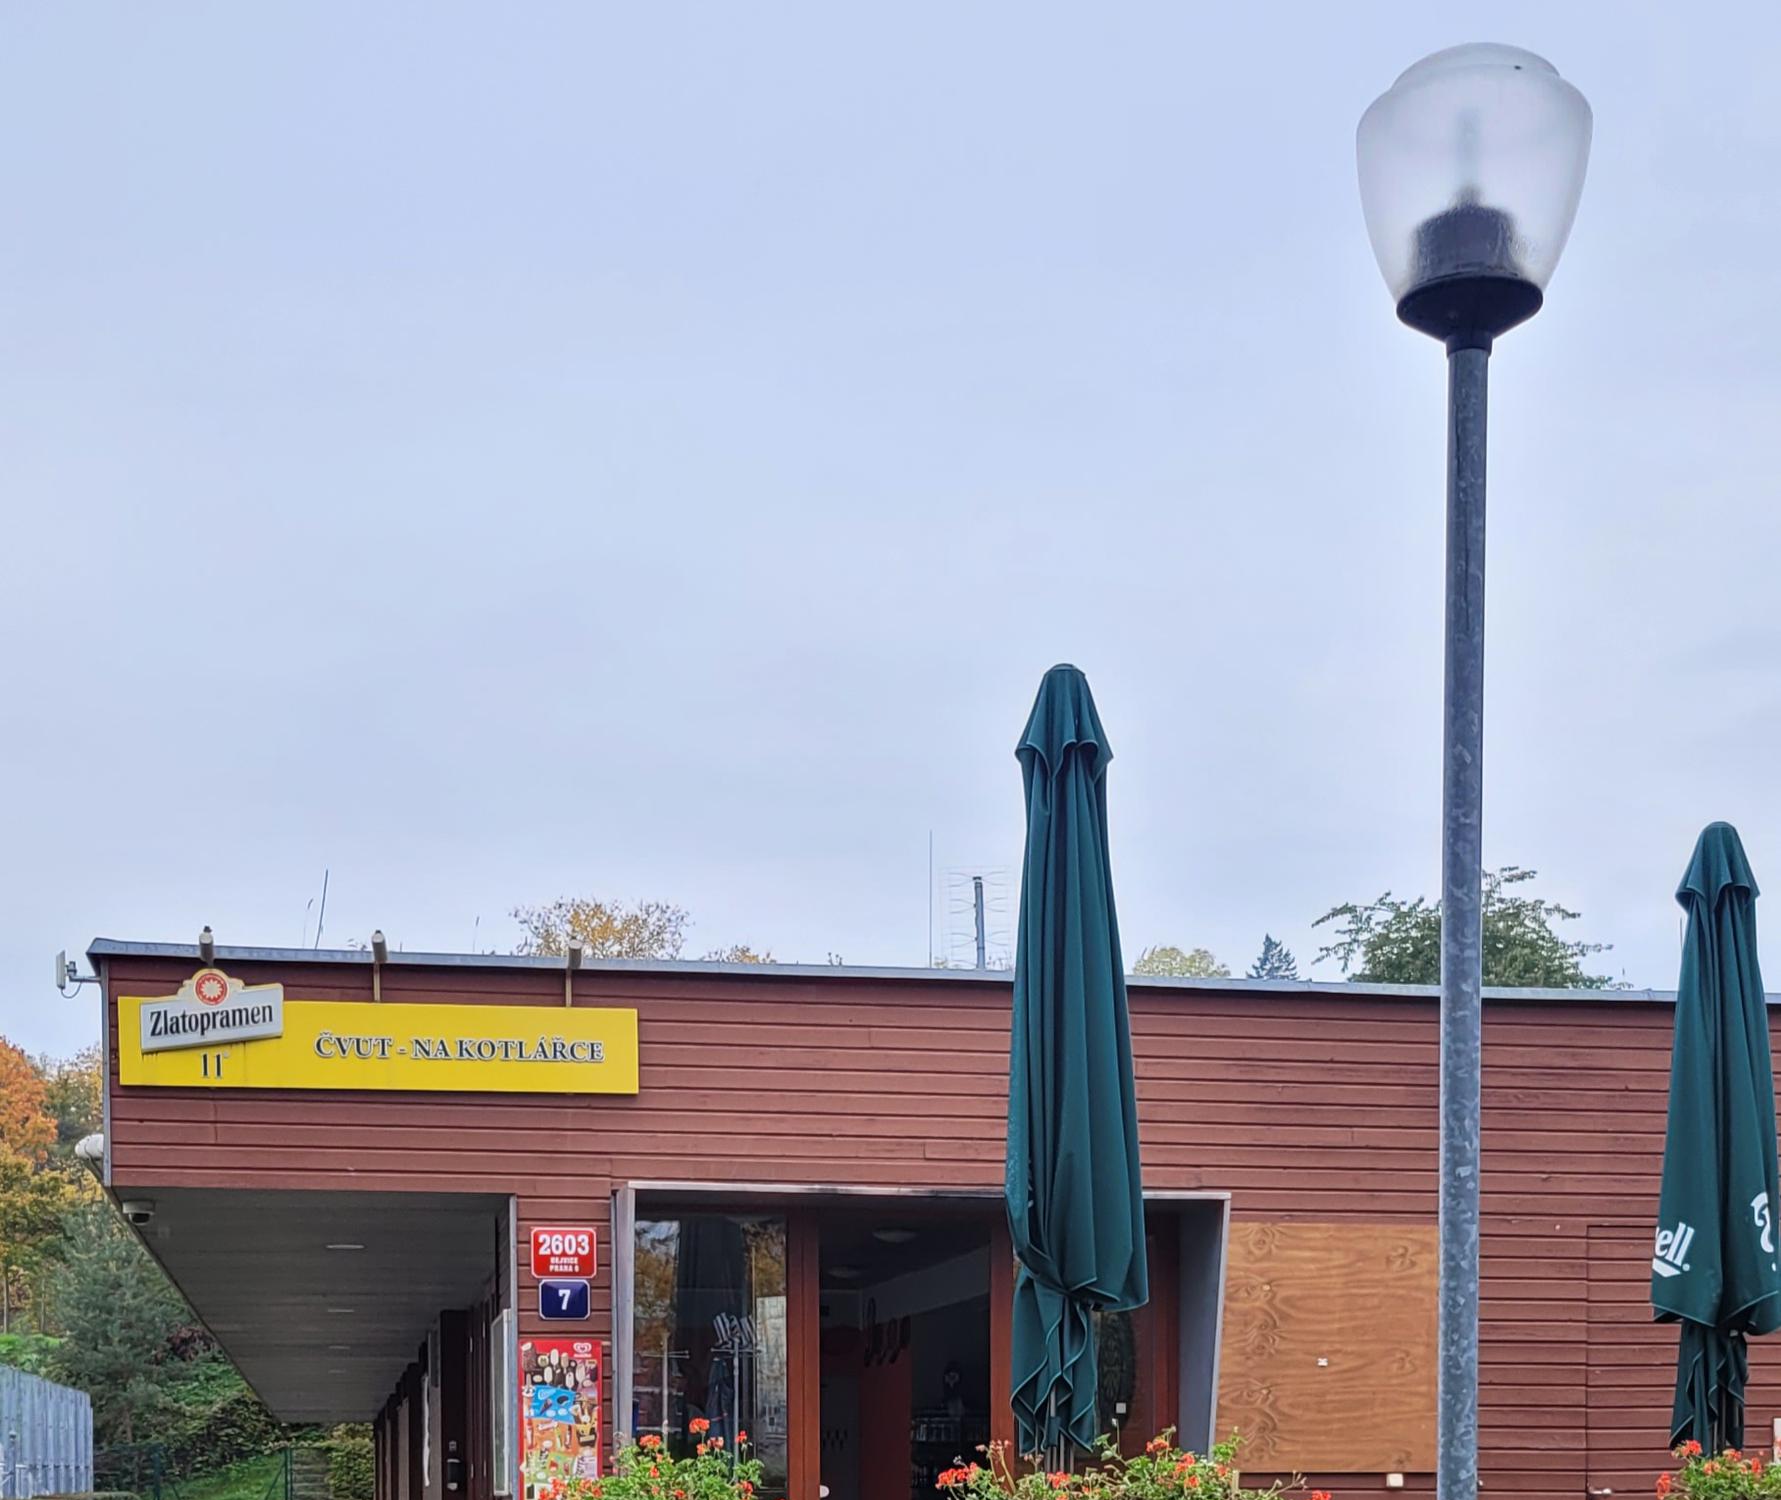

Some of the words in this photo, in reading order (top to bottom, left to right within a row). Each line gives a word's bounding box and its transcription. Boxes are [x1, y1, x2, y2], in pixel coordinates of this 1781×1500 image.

[150, 1004, 273, 1037] Zlatopramen
[314, 1031, 392, 1058] ČVUT
[411, 1037, 451, 1059] NA
[455, 1036, 605, 1063] KOTLÁŘCE
[538, 1234, 590, 1256] 2603
[558, 1289, 571, 1311] 7
